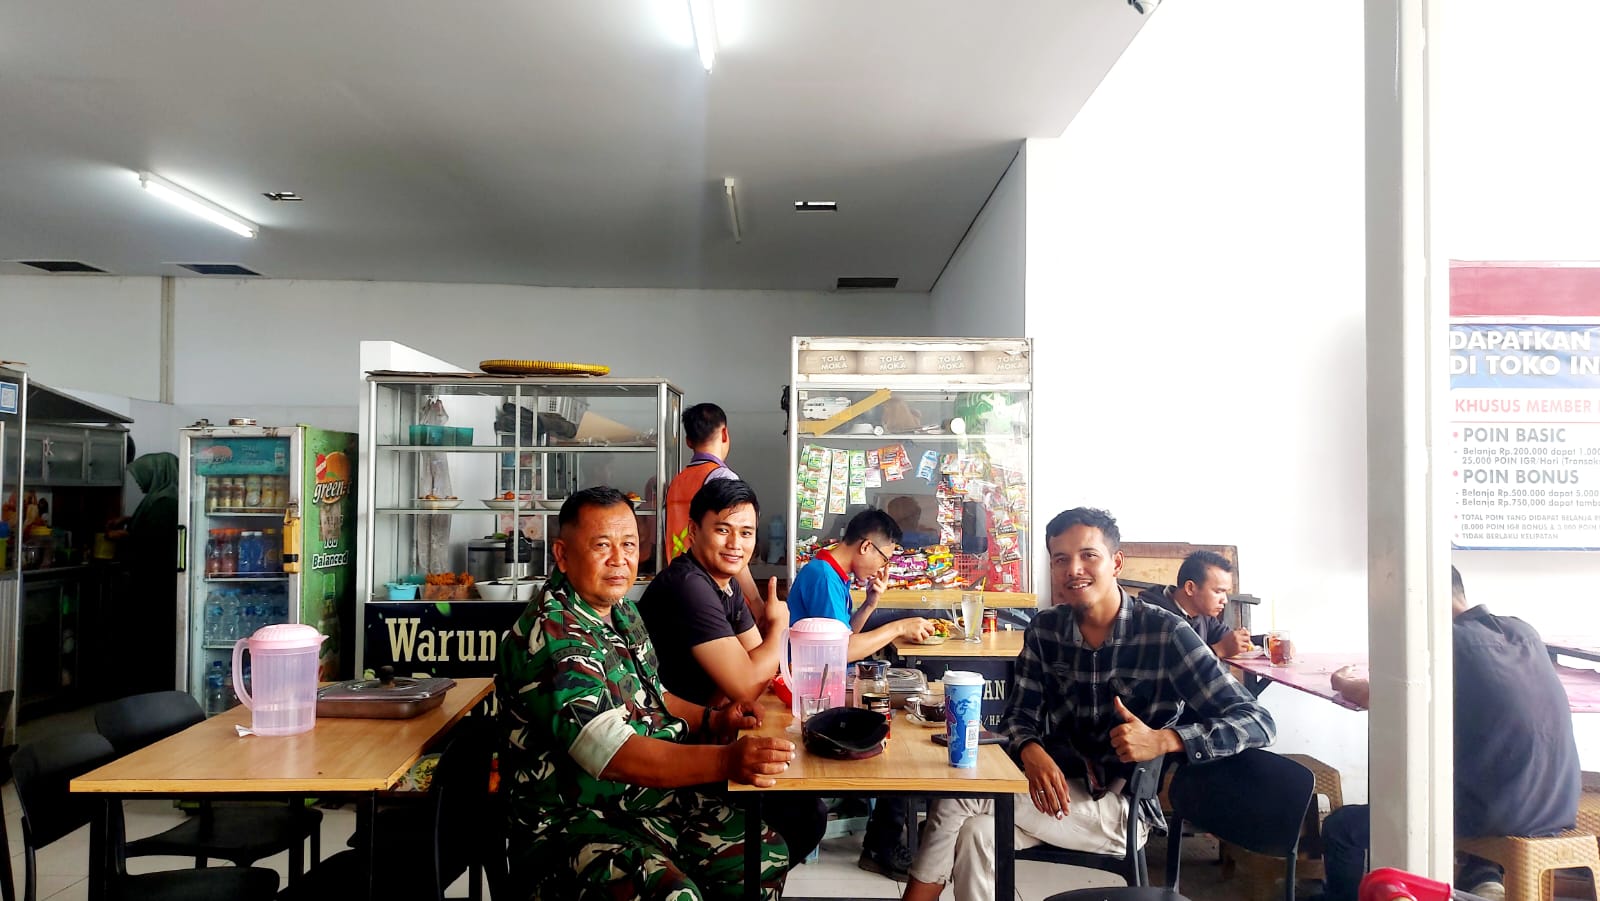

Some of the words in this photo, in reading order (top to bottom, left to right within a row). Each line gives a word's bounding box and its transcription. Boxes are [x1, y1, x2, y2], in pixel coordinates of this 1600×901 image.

[1449, 330, 1591, 351] DAPATKAN
[1449, 355, 1477, 376] DI
[1486, 355, 1561, 376] TOKO
[1455, 399, 1521, 413] KHUSUS
[1526, 399, 1592, 413] MEMBER
[1463, 427, 1509, 442] POIN
[1516, 427, 1566, 442] BASIC
[1463, 447, 1497, 457] Belanja
[1499, 447, 1548, 457] Rp.200.000
[1551, 447, 1576, 457] dapat
[1462, 457, 1492, 465] 25.000
[1494, 457, 1517, 465] POIN
[1463, 469, 1509, 484] POIN
[1516, 469, 1579, 484] BONUS
[1462, 489, 1495, 499] Belanja
[1548, 489, 1573, 499] dapat
[1462, 498, 1495, 508] Belanja
[1548, 499, 1573, 508] dapat
[311, 552, 349, 570] Balanced
[385, 617, 511, 662] Warun
